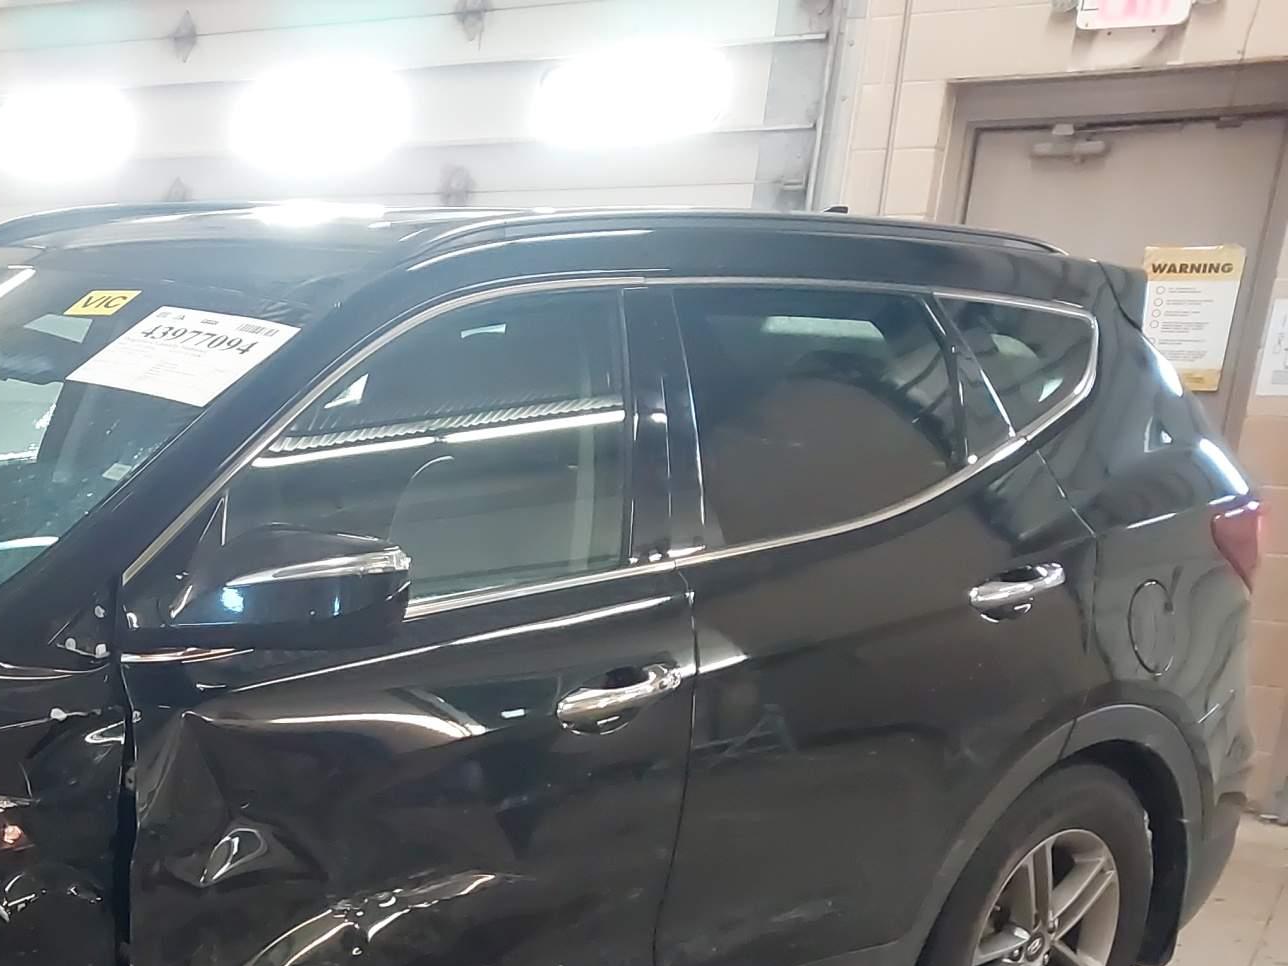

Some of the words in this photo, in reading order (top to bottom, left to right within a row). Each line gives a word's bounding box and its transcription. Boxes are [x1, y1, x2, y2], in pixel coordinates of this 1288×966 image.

[1151, 262, 1234, 275] WARNING
[81, 295, 128, 310] VIC
[141, 324, 258, 355] 43977094
